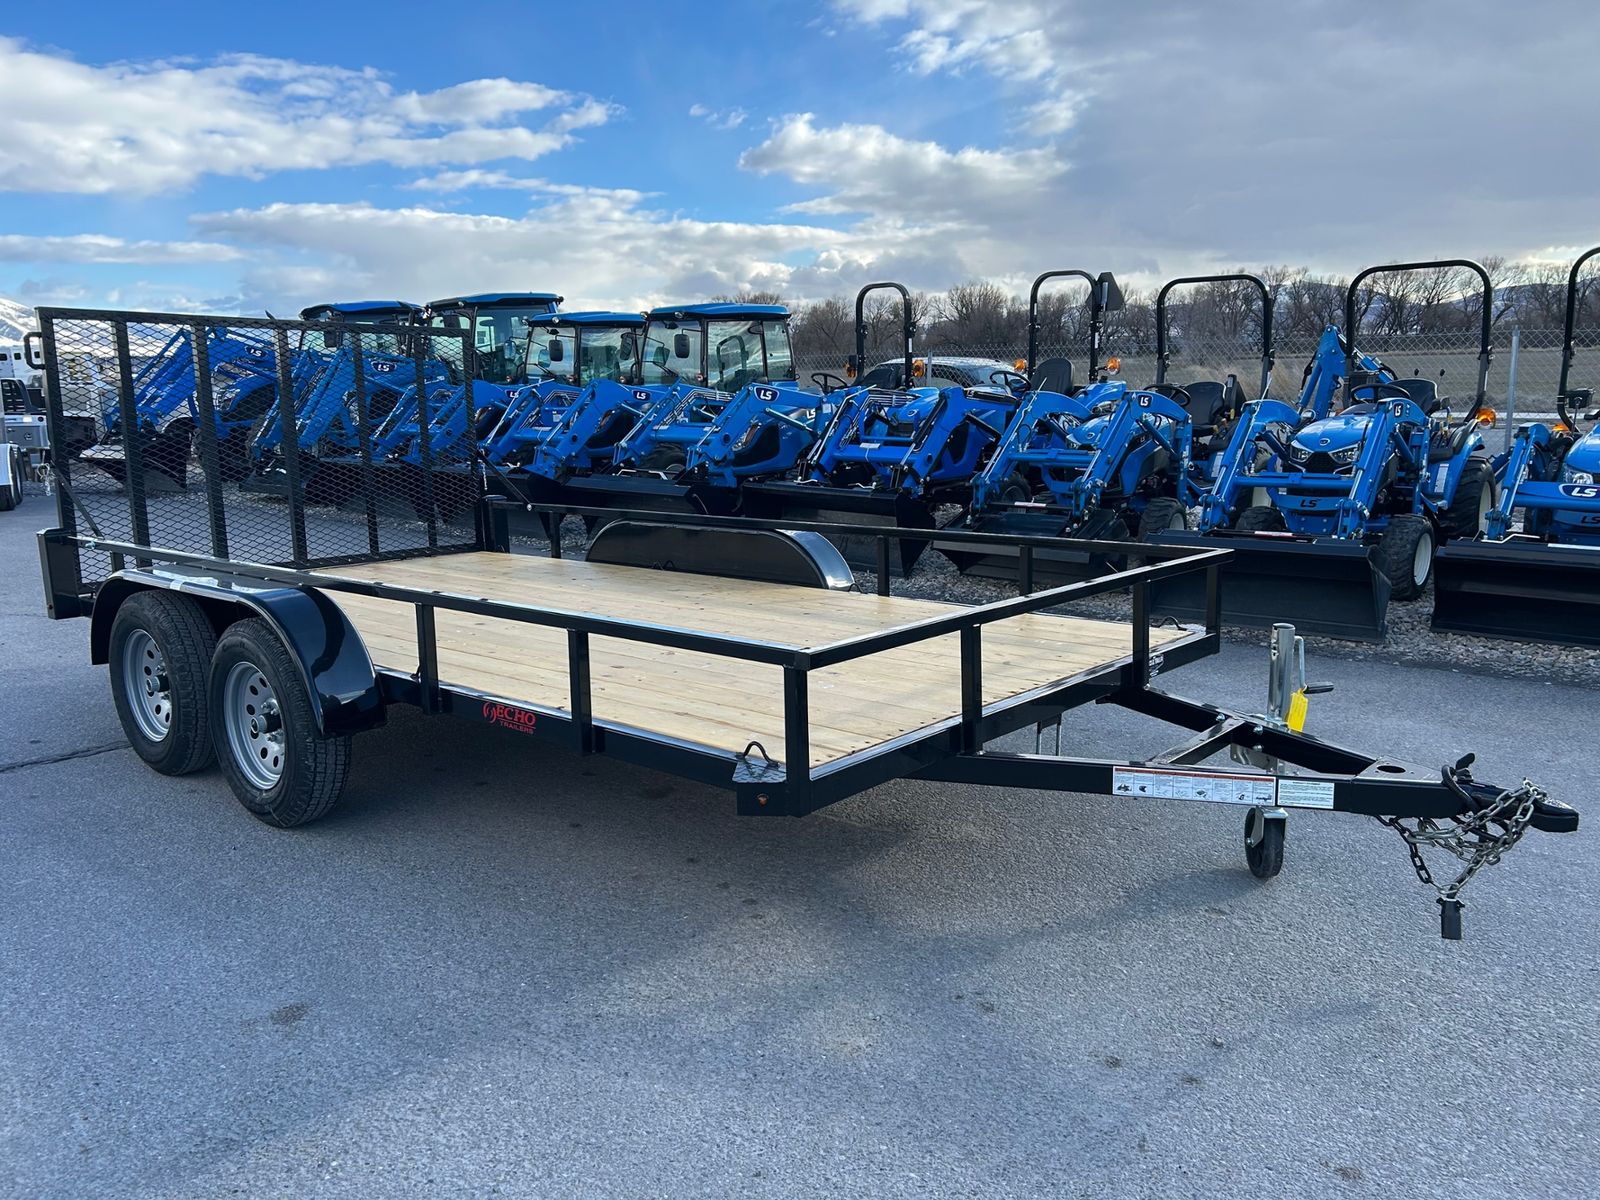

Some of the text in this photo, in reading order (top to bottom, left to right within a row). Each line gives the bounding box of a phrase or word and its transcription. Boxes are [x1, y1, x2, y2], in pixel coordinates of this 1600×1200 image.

[377, 363, 390, 372] LS
[636, 391, 647, 400] LS
[760, 389, 773, 400] LS
[1140, 396, 1149, 407] LS
[806, 408, 816, 419] LS
[1394, 405, 1402, 416] LS
[1571, 487, 1598, 498] LS
[1300, 499, 1318, 508] LS
[495, 703, 537, 726] ECHO
[500, 720, 534, 735] TRAILERS
